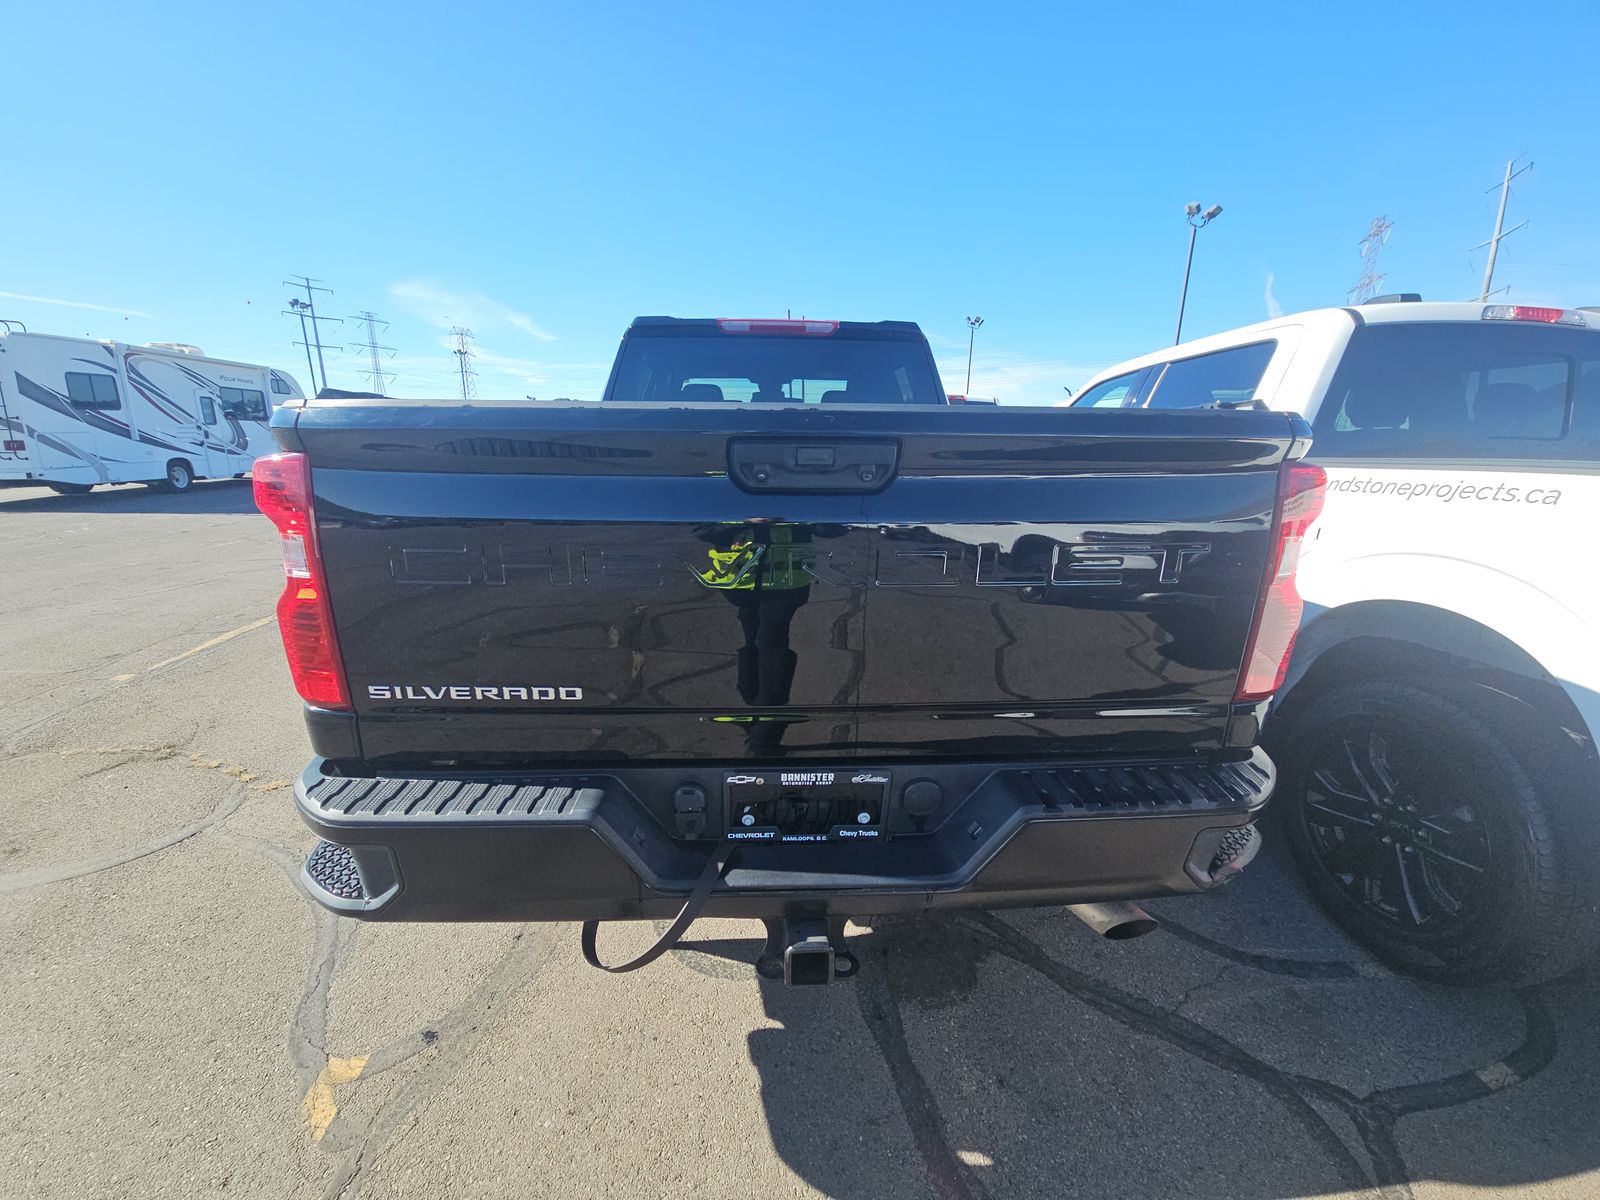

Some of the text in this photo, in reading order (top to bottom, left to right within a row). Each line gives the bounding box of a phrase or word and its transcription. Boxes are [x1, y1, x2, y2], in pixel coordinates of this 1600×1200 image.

[1327, 476, 1562, 505] ndstoneprojects.ca
[367, 685, 584, 701] SILVERADO
[781, 773, 834, 781] BANNISTER
